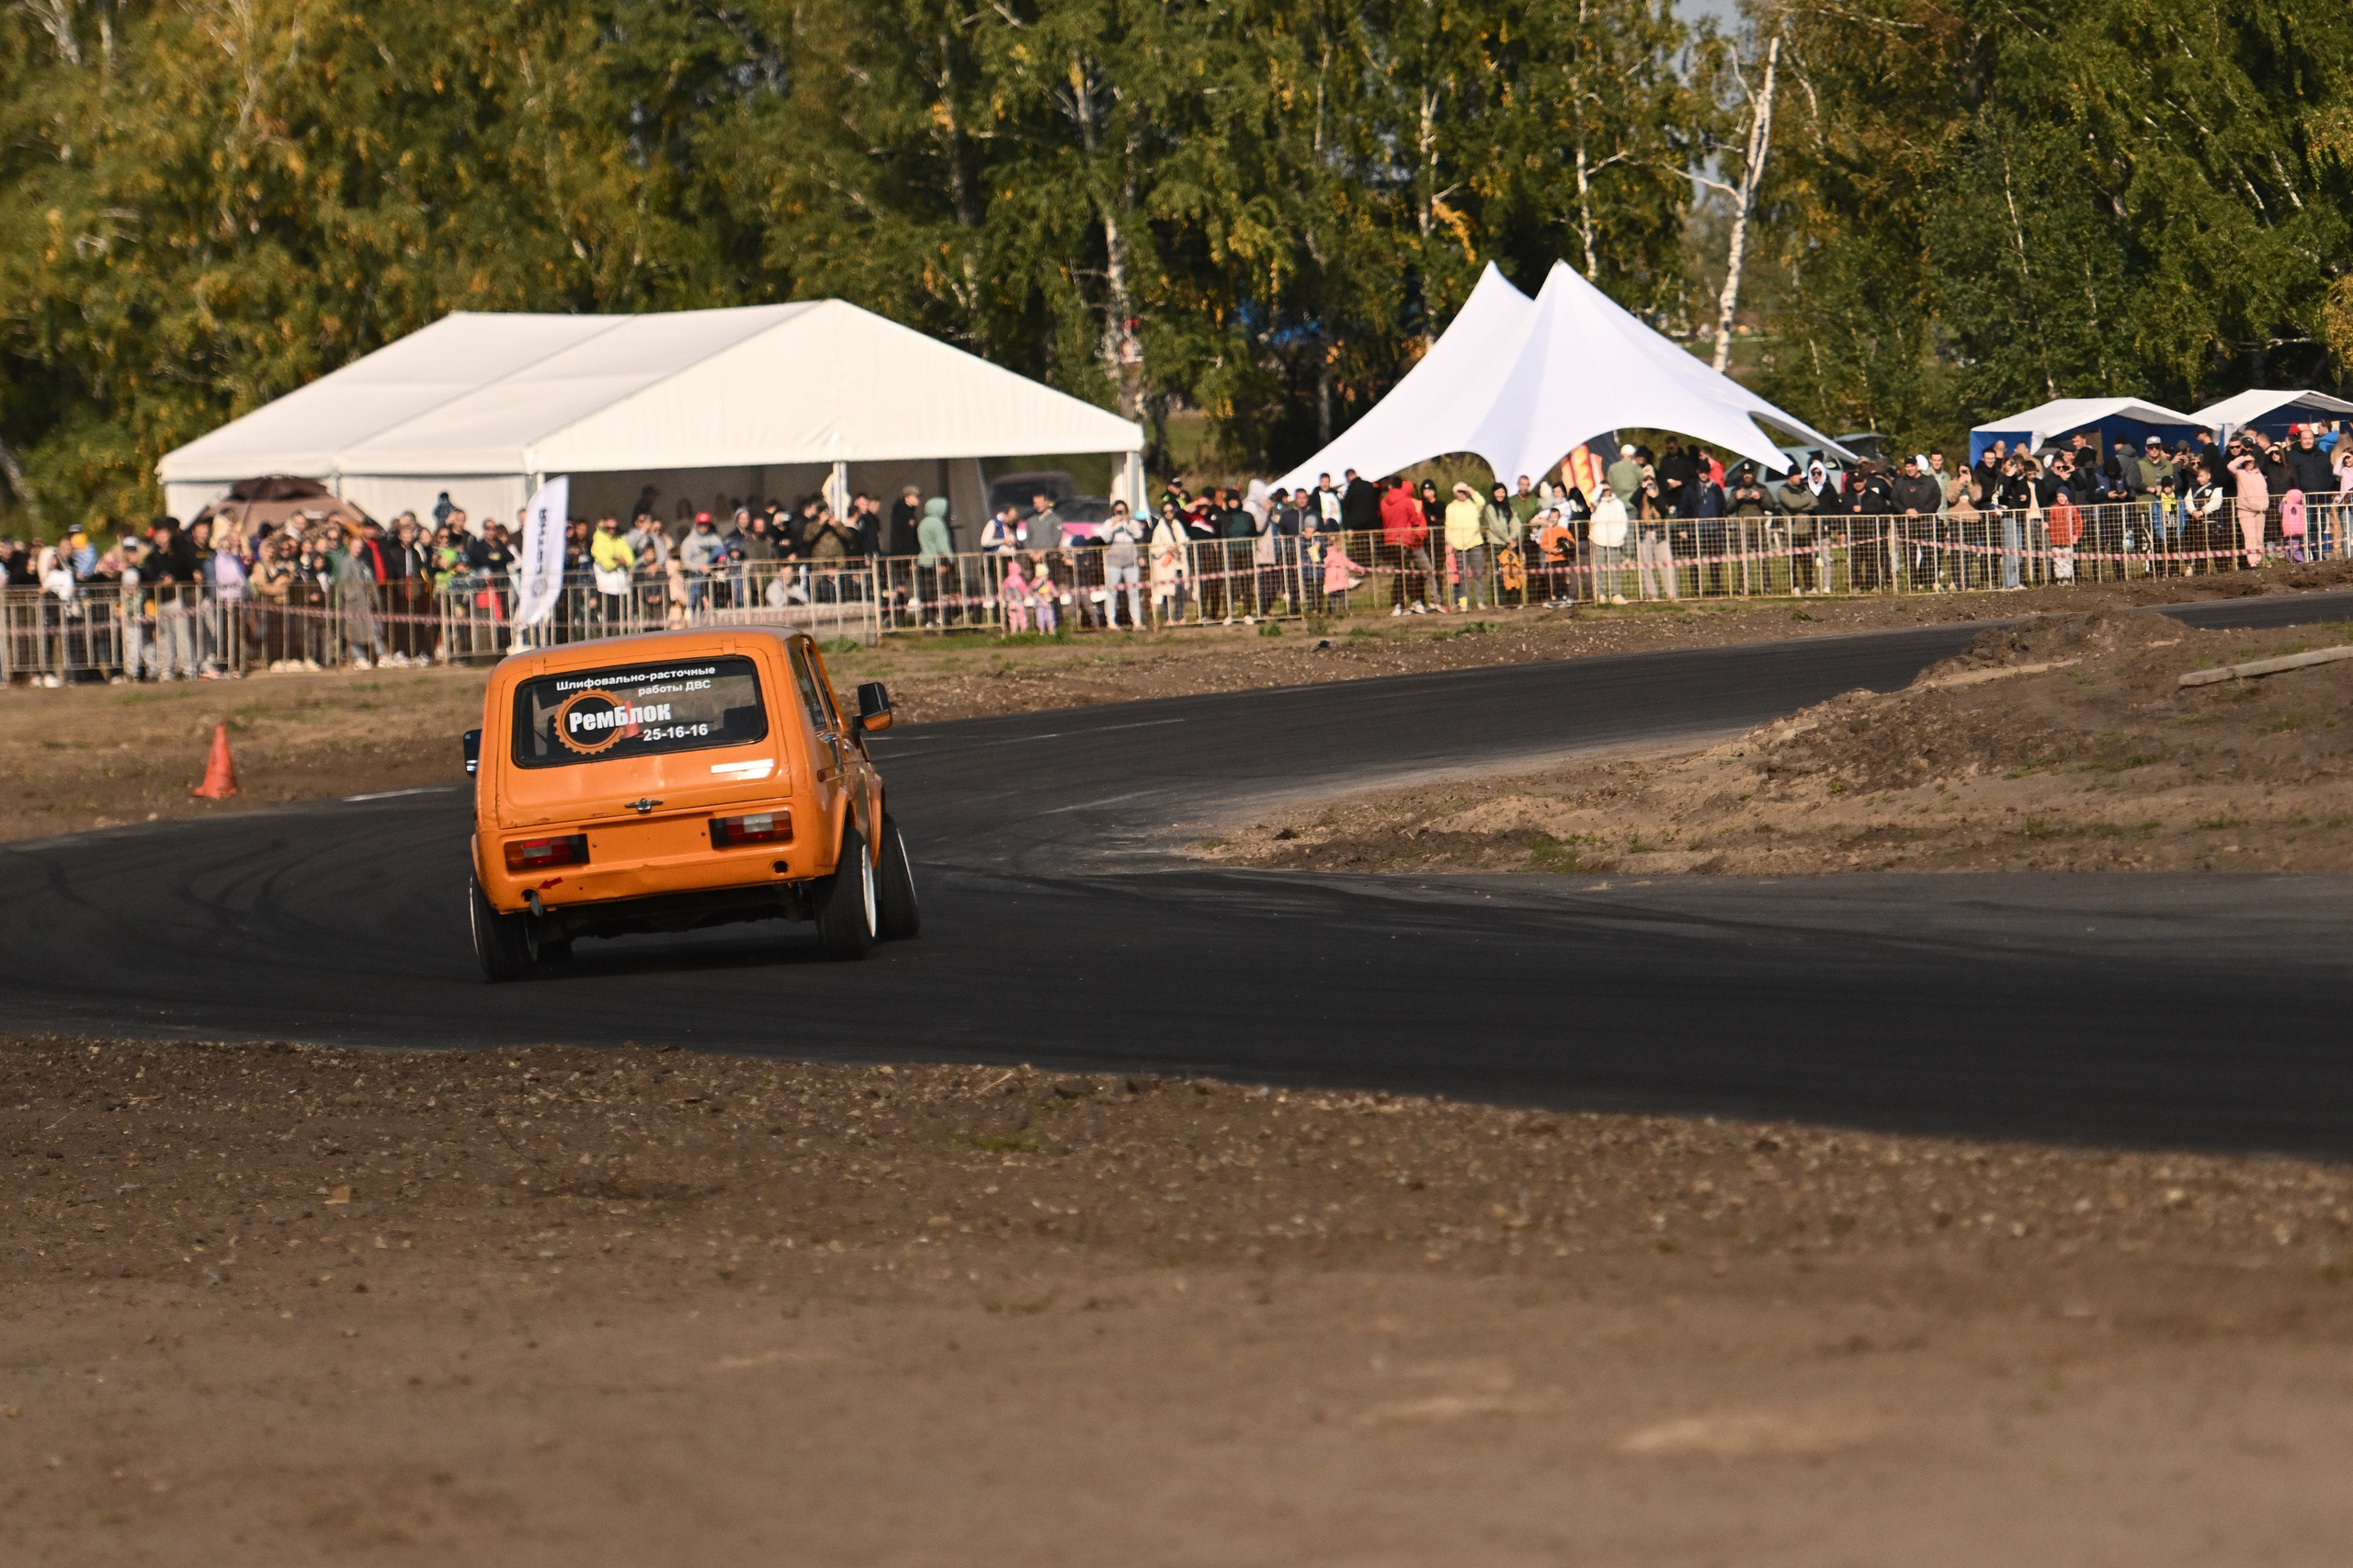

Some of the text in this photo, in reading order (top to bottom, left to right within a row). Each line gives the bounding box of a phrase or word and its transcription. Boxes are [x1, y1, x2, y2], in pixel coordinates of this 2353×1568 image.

[556, 666, 716, 691] Шлифовально-расточные
[638, 679, 710, 697] работы ДВС
[569, 703, 671, 733] РемБлок
[642, 723, 709, 742] 25-16-16
